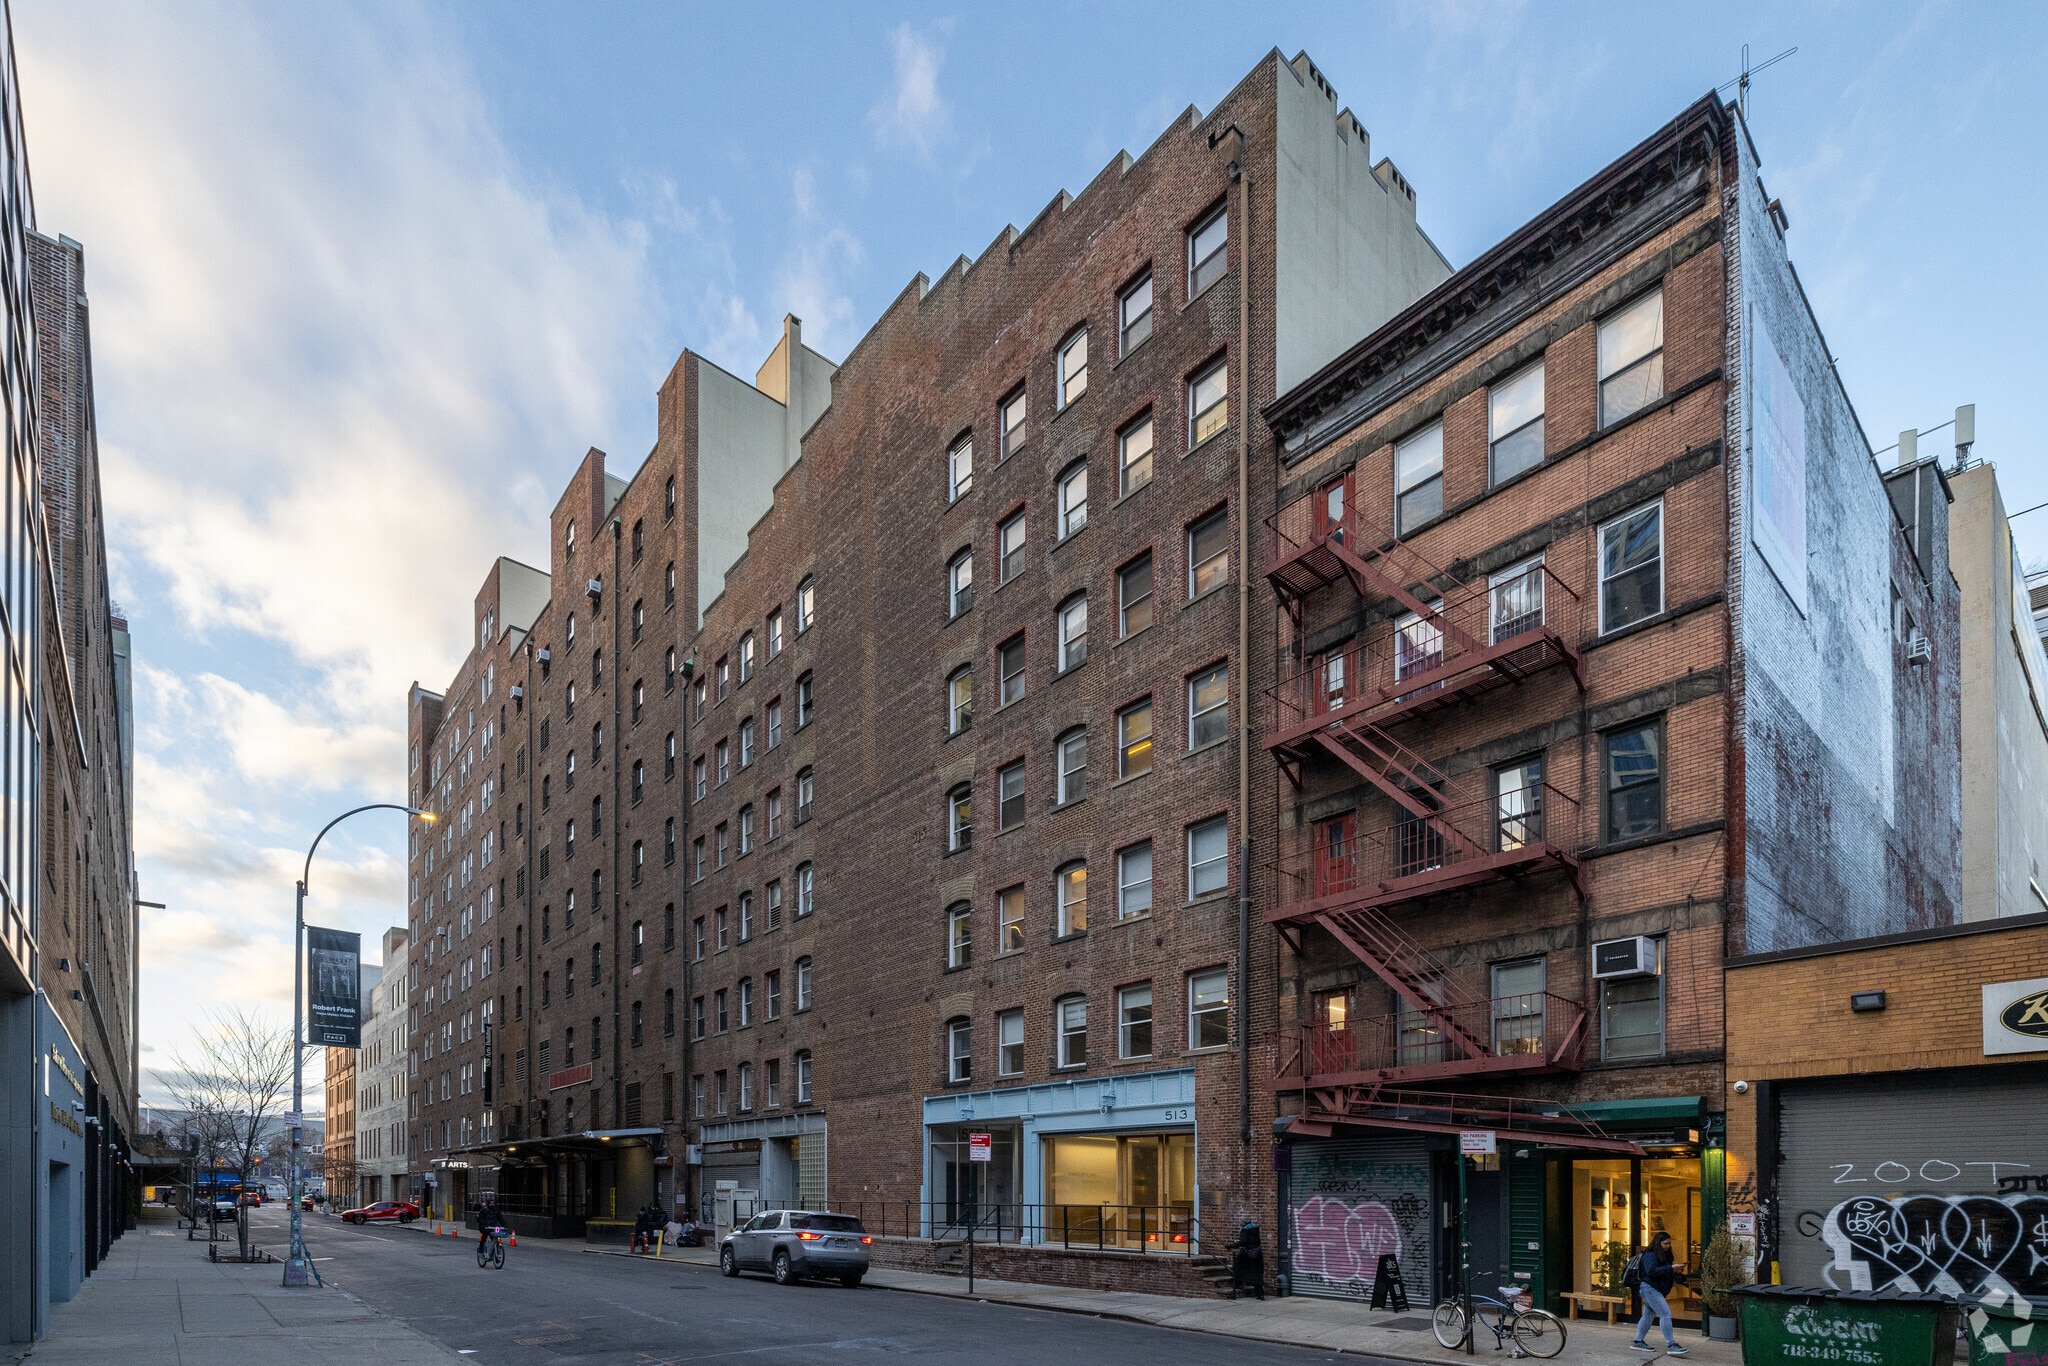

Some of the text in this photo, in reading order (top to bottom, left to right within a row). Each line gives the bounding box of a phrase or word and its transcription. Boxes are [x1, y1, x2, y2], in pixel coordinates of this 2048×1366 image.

[312, 1004, 356, 1014] Robert Frank
[1165, 1109, 1188, 1121] 513
[1829, 1159, 2031, 1184] ZOOT
